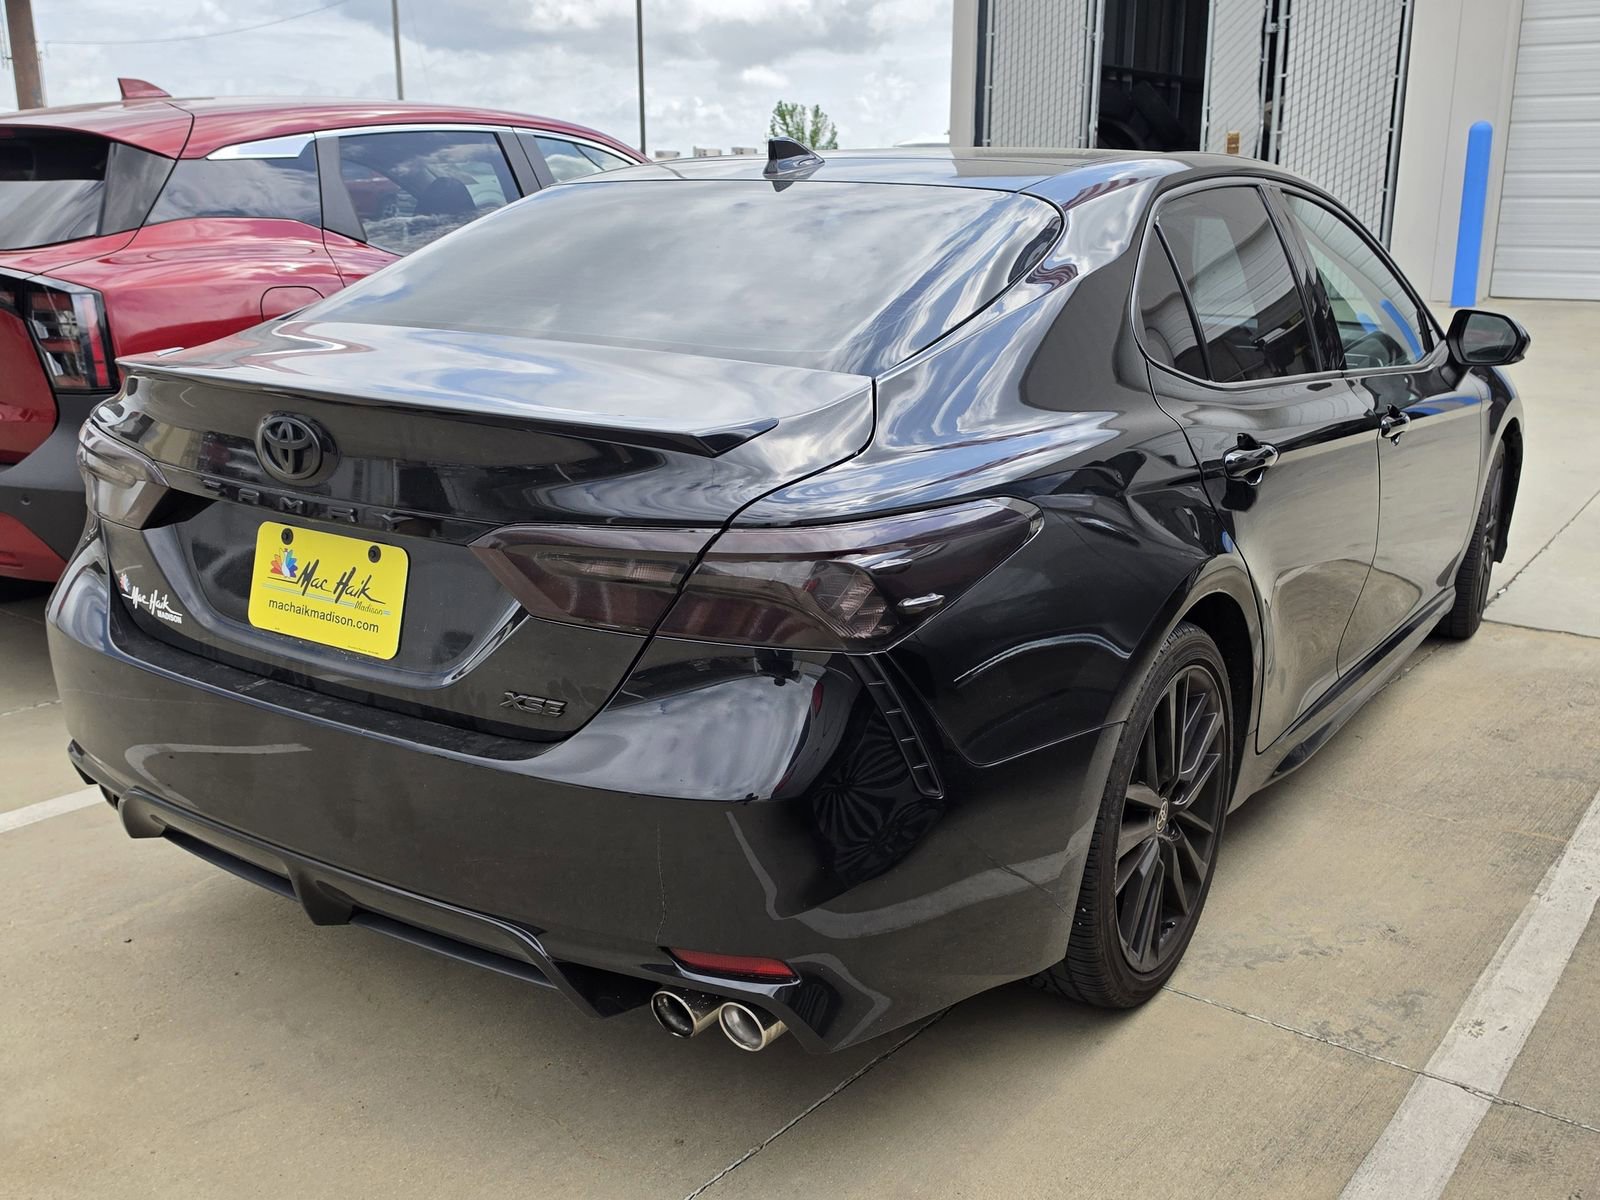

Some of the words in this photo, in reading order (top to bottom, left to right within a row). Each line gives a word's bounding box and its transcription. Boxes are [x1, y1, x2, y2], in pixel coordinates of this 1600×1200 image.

[268, 559, 332, 596] Mac
[333, 566, 386, 604] Haik
[121, 585, 149, 609] Mac
[149, 589, 183, 616] Haik
[268, 599, 379, 633] machaikmadison.com
[354, 600, 383, 616] Madison
[499, 691, 568, 718] XSE
